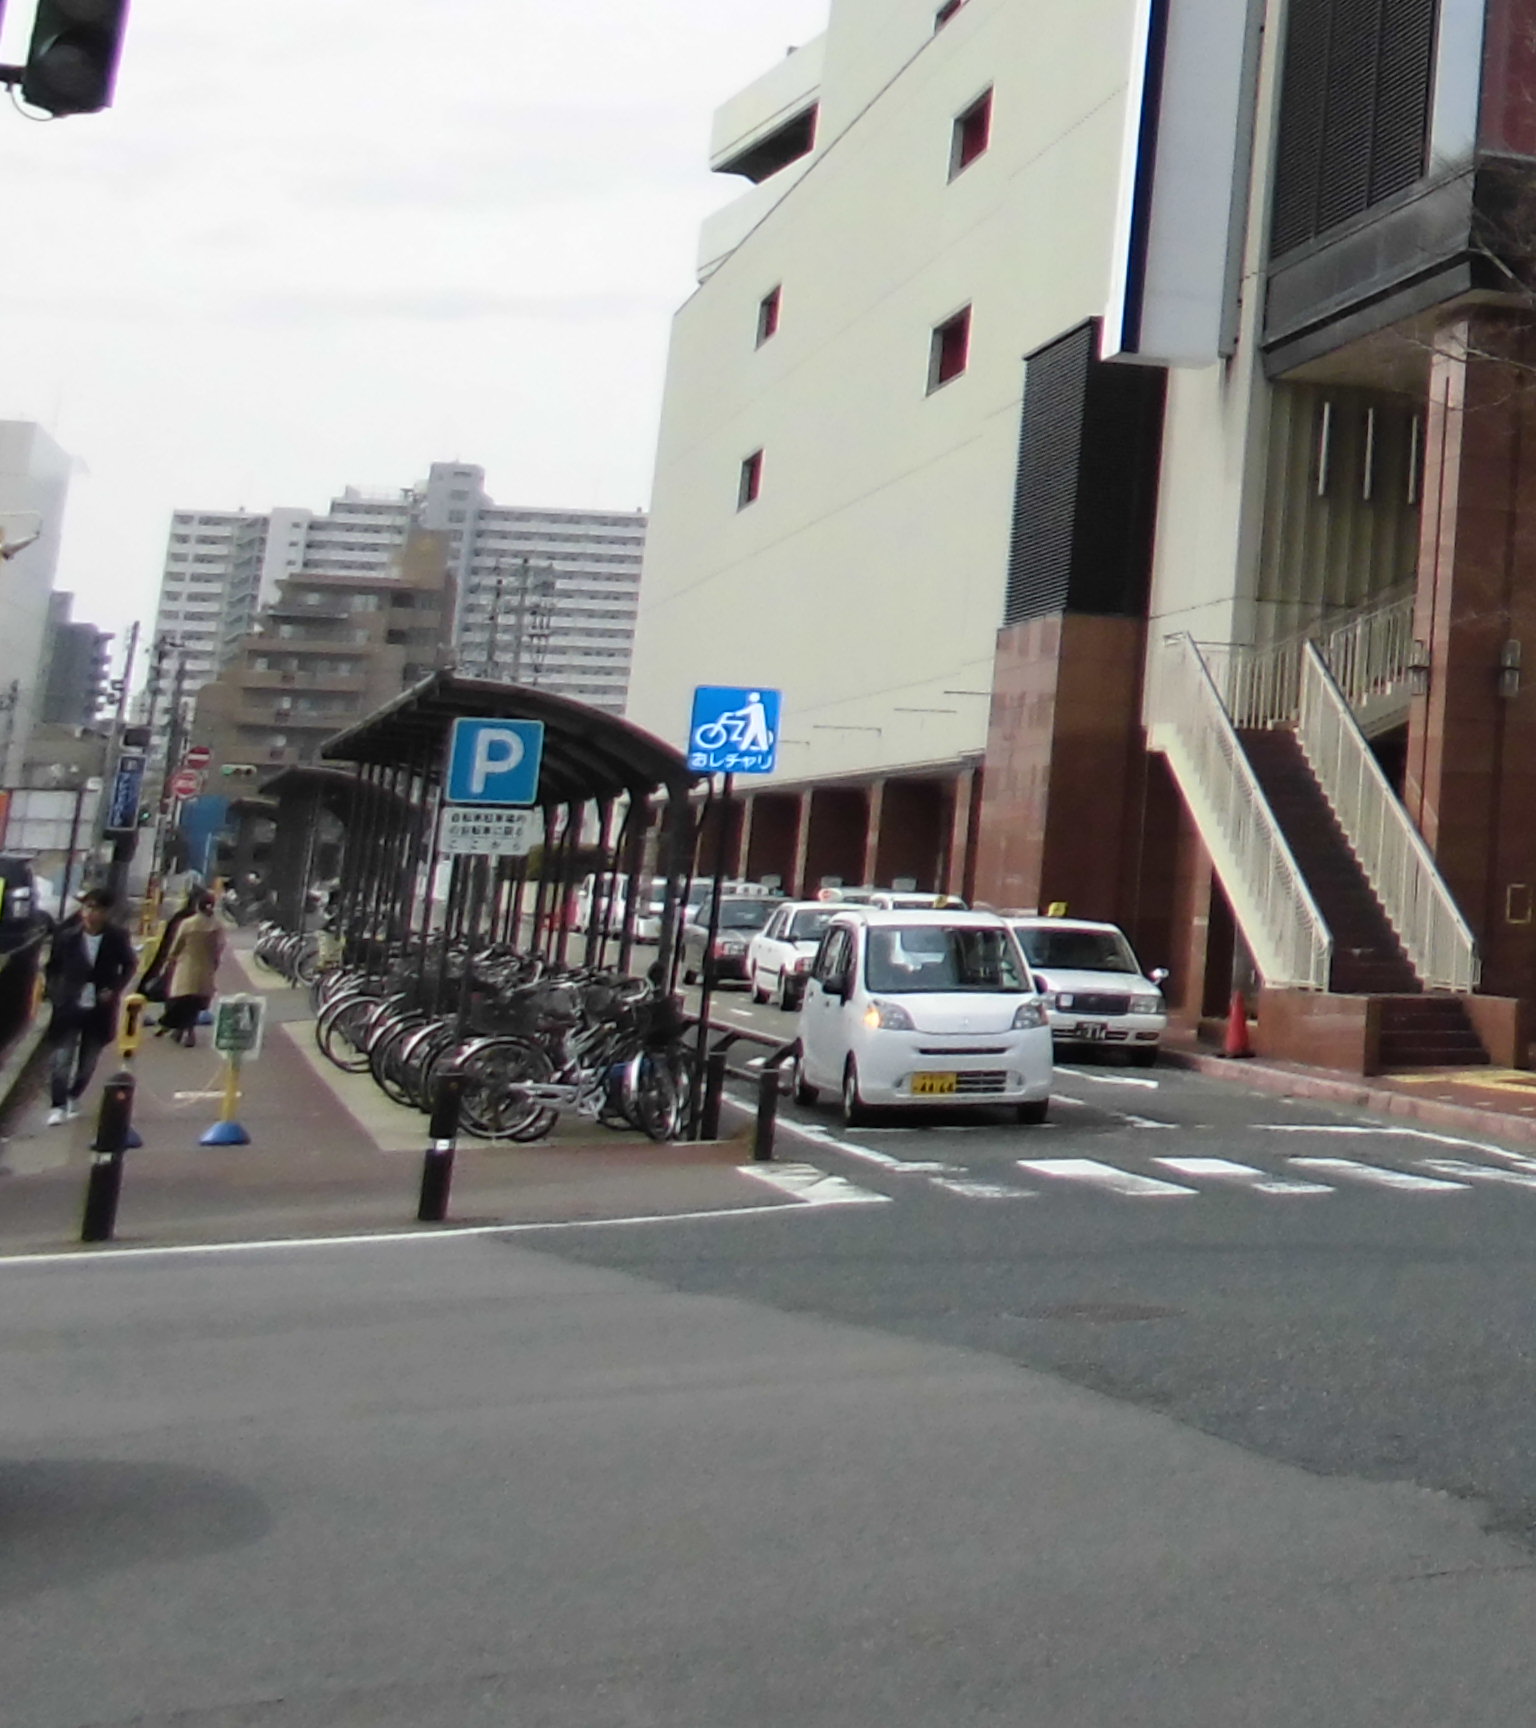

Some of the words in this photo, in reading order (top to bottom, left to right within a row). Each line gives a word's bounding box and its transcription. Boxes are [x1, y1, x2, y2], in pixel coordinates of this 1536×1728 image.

[470, 728, 524, 794] P
[692, 752, 773, 770] おしチャリ
